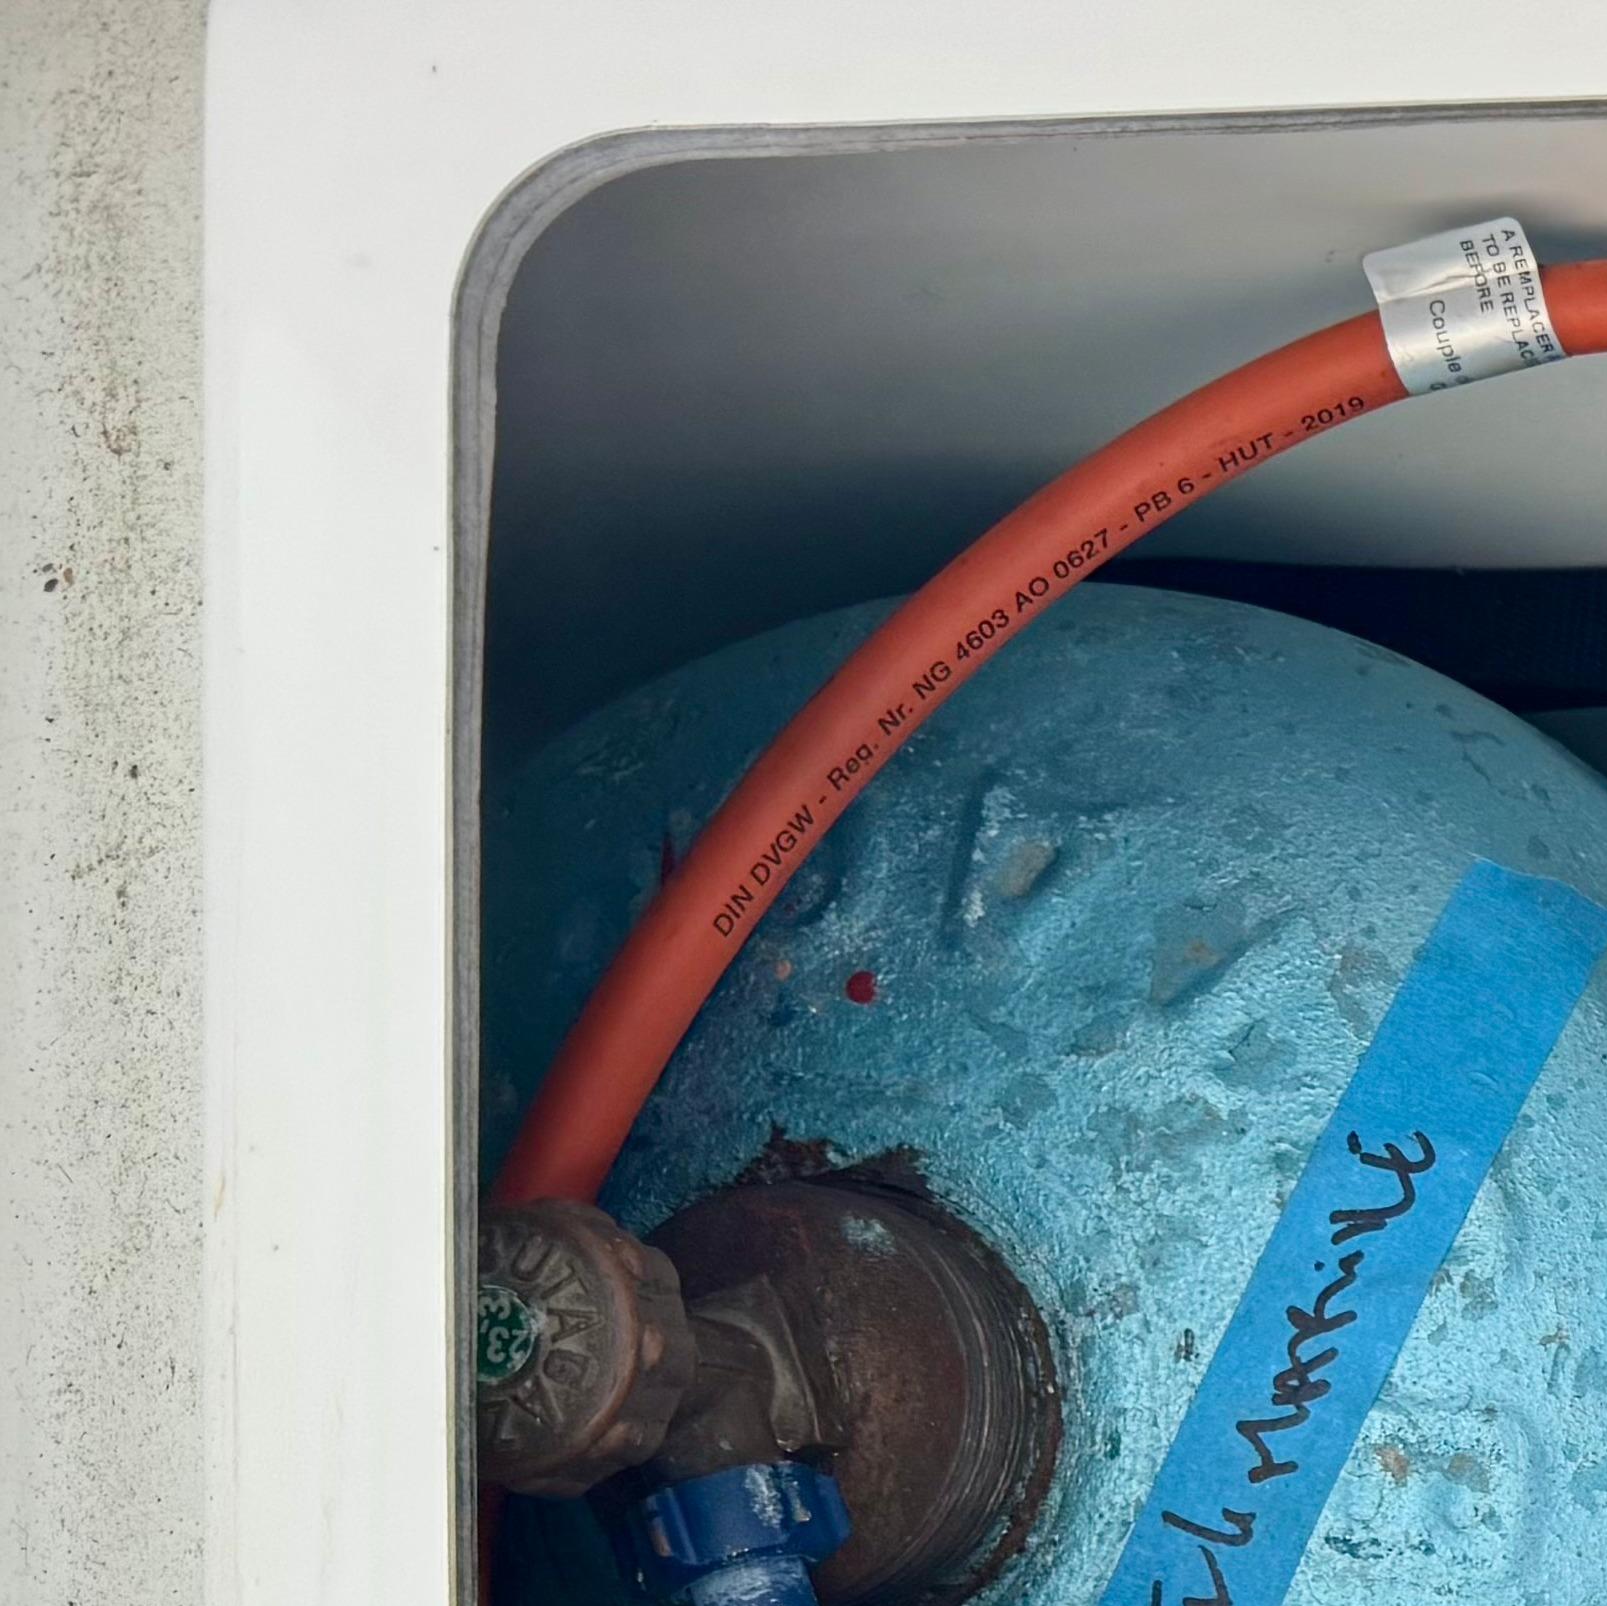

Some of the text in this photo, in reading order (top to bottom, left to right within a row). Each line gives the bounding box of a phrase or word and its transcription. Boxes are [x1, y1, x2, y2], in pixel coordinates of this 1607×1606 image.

[1460, 240, 1495, 314] BEFORE
[1482, 233, 1500, 257] TO
[1492, 262, 1511, 288] BE
[1501, 229, 1553, 355] A REMPLACER
[1429, 300, 1462, 373] Couple
[712, 884, 754, 939] DIN
[749, 805, 817, 884] DVGW
[876, 699, 915, 737] Nr.
[911, 659, 954, 700] NG
[953, 608, 1011, 663] 4603
[1012, 576, 1052, 613] AO
[1052, 530, 1113, 581] 0627
[1133, 490, 1174, 524] PB
[1176, 476, 1197, 497] 6
[1217, 431, 1276, 474] HUT
[1300, 395, 1366, 433] 2019
